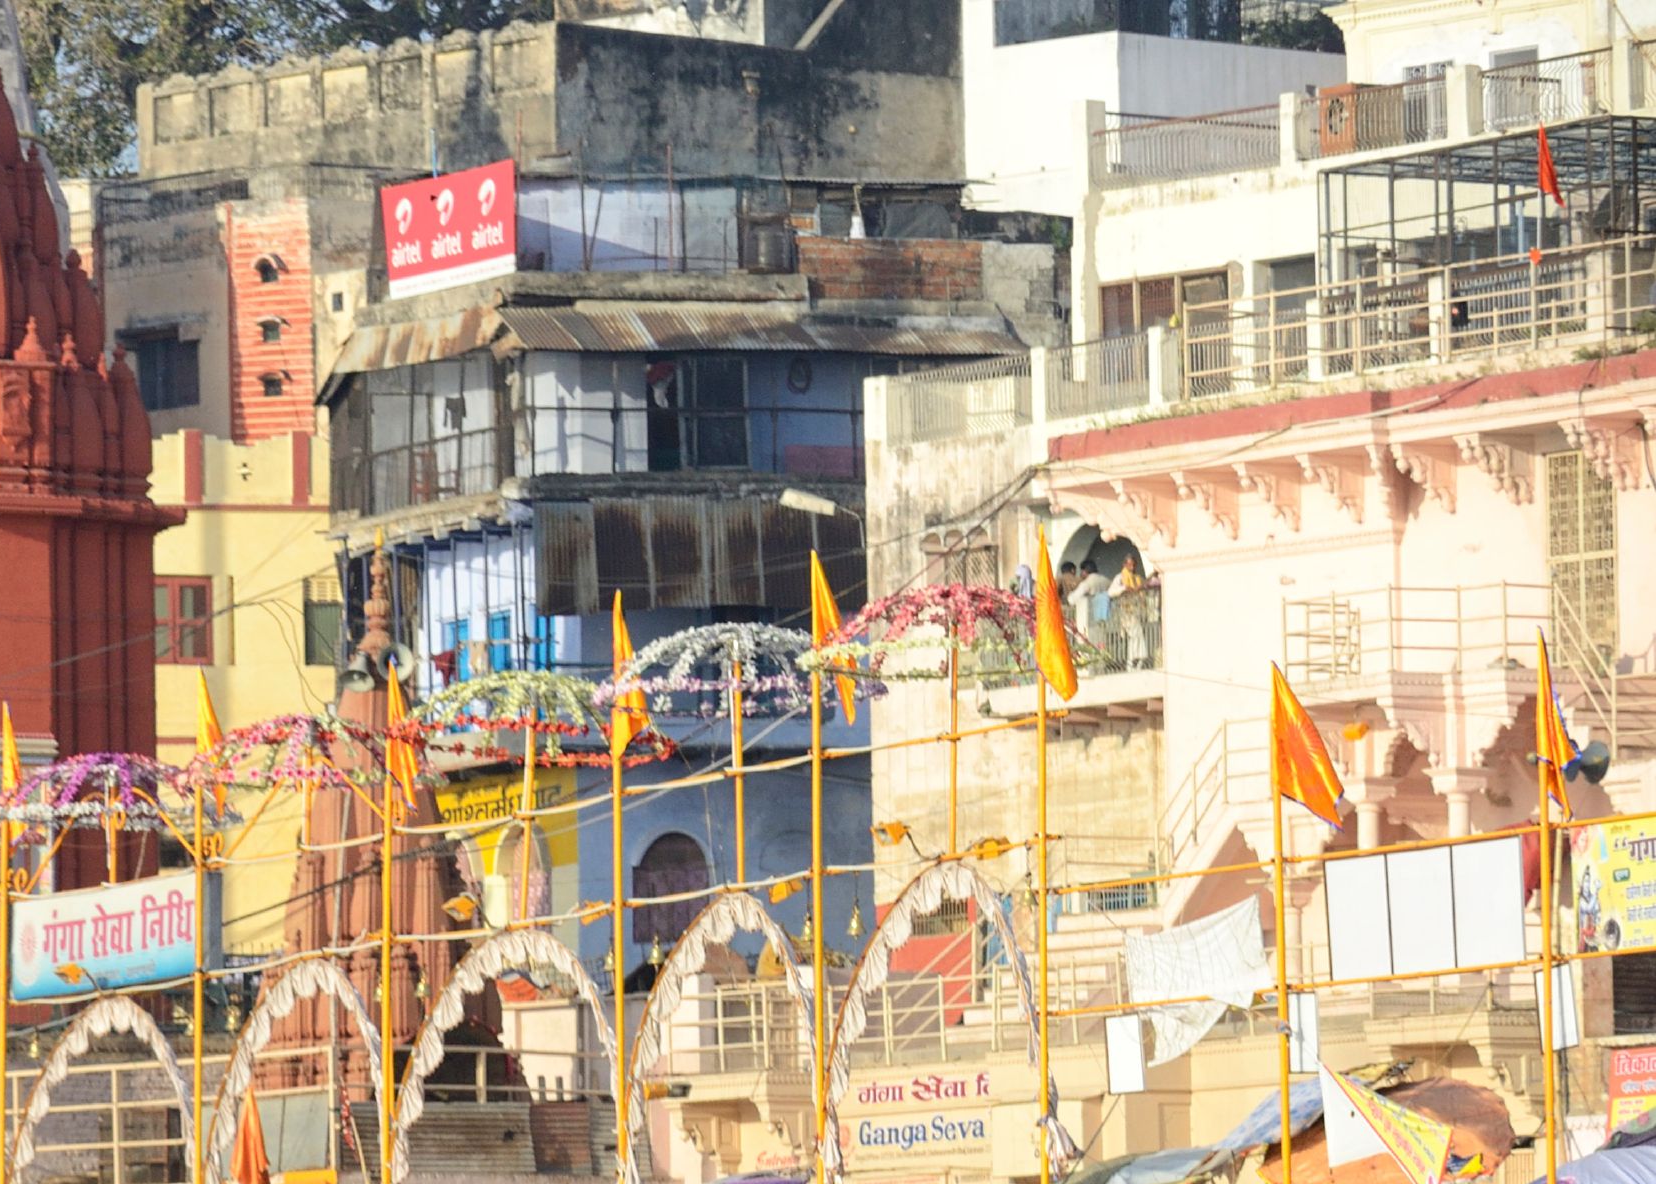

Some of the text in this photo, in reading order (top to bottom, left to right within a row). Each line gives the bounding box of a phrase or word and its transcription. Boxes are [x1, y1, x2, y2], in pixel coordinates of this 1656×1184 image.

[391, 221, 504, 268] airtel airtel airtel
[43, 890, 195, 963] गंगा सेवा निधि
[857, 1082, 904, 1104] गंगा
[911, 1075, 967, 1102] सेवा
[859, 1115, 985, 1151] Ganga Seva
